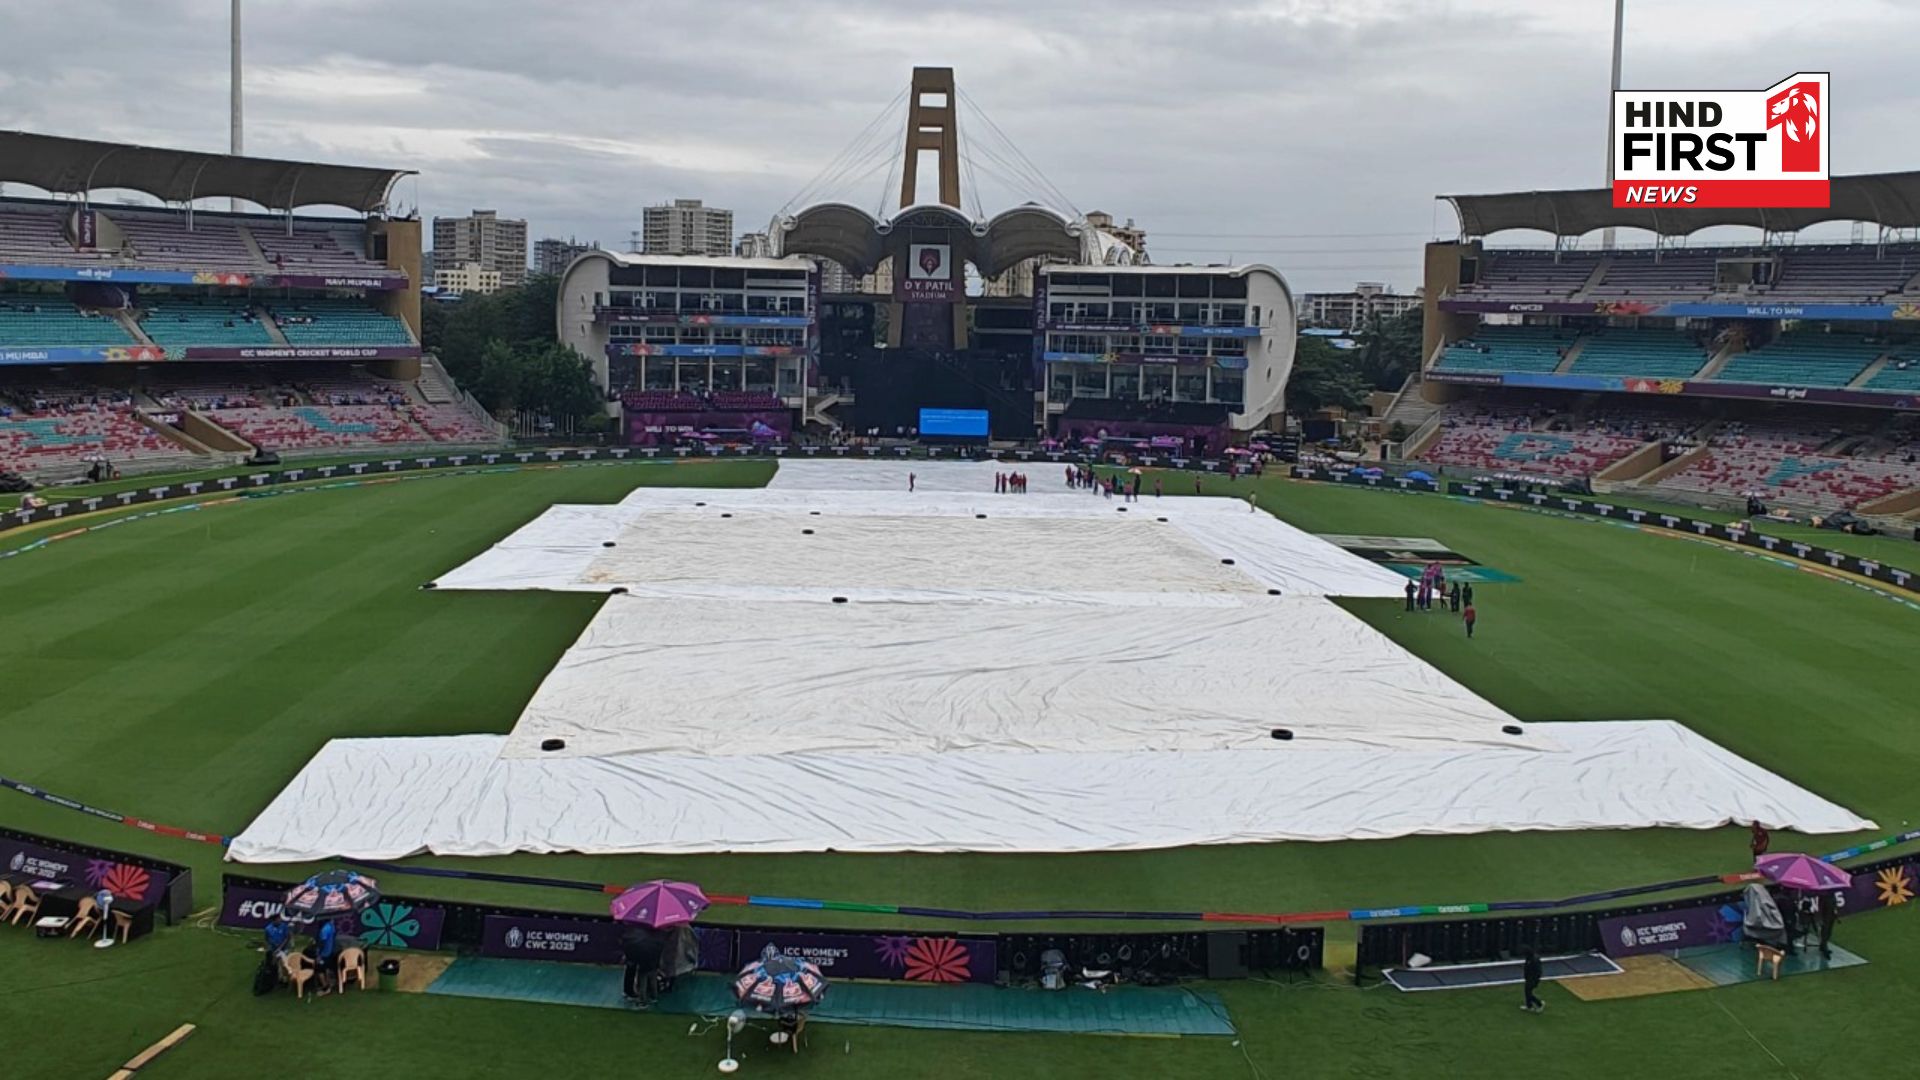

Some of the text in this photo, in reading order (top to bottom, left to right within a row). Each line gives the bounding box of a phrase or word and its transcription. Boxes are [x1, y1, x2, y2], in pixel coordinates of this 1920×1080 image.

[325, 278, 382, 287] NAVI MUMBAI
[915, 281, 923, 290] Y
[925, 281, 954, 291] PATIL
[1769, 307, 1783, 315] TO
[1784, 307, 1804, 315] WIN
[6, 351, 48, 360] MUMBAI
[26, 857, 68, 873] ICC WOMEN'S
[22, 865, 57, 878] CWC 2025
[1636, 921, 1687, 937] ICC WOMEN'S
[526, 931, 589, 943] ICC WOMEN'S
[1639, 932, 1680, 945] CWC 2025
[525, 940, 576, 951] CWC 2025
[784, 946, 800, 957] ICC
[802, 948, 849, 958] WOMEN'S
